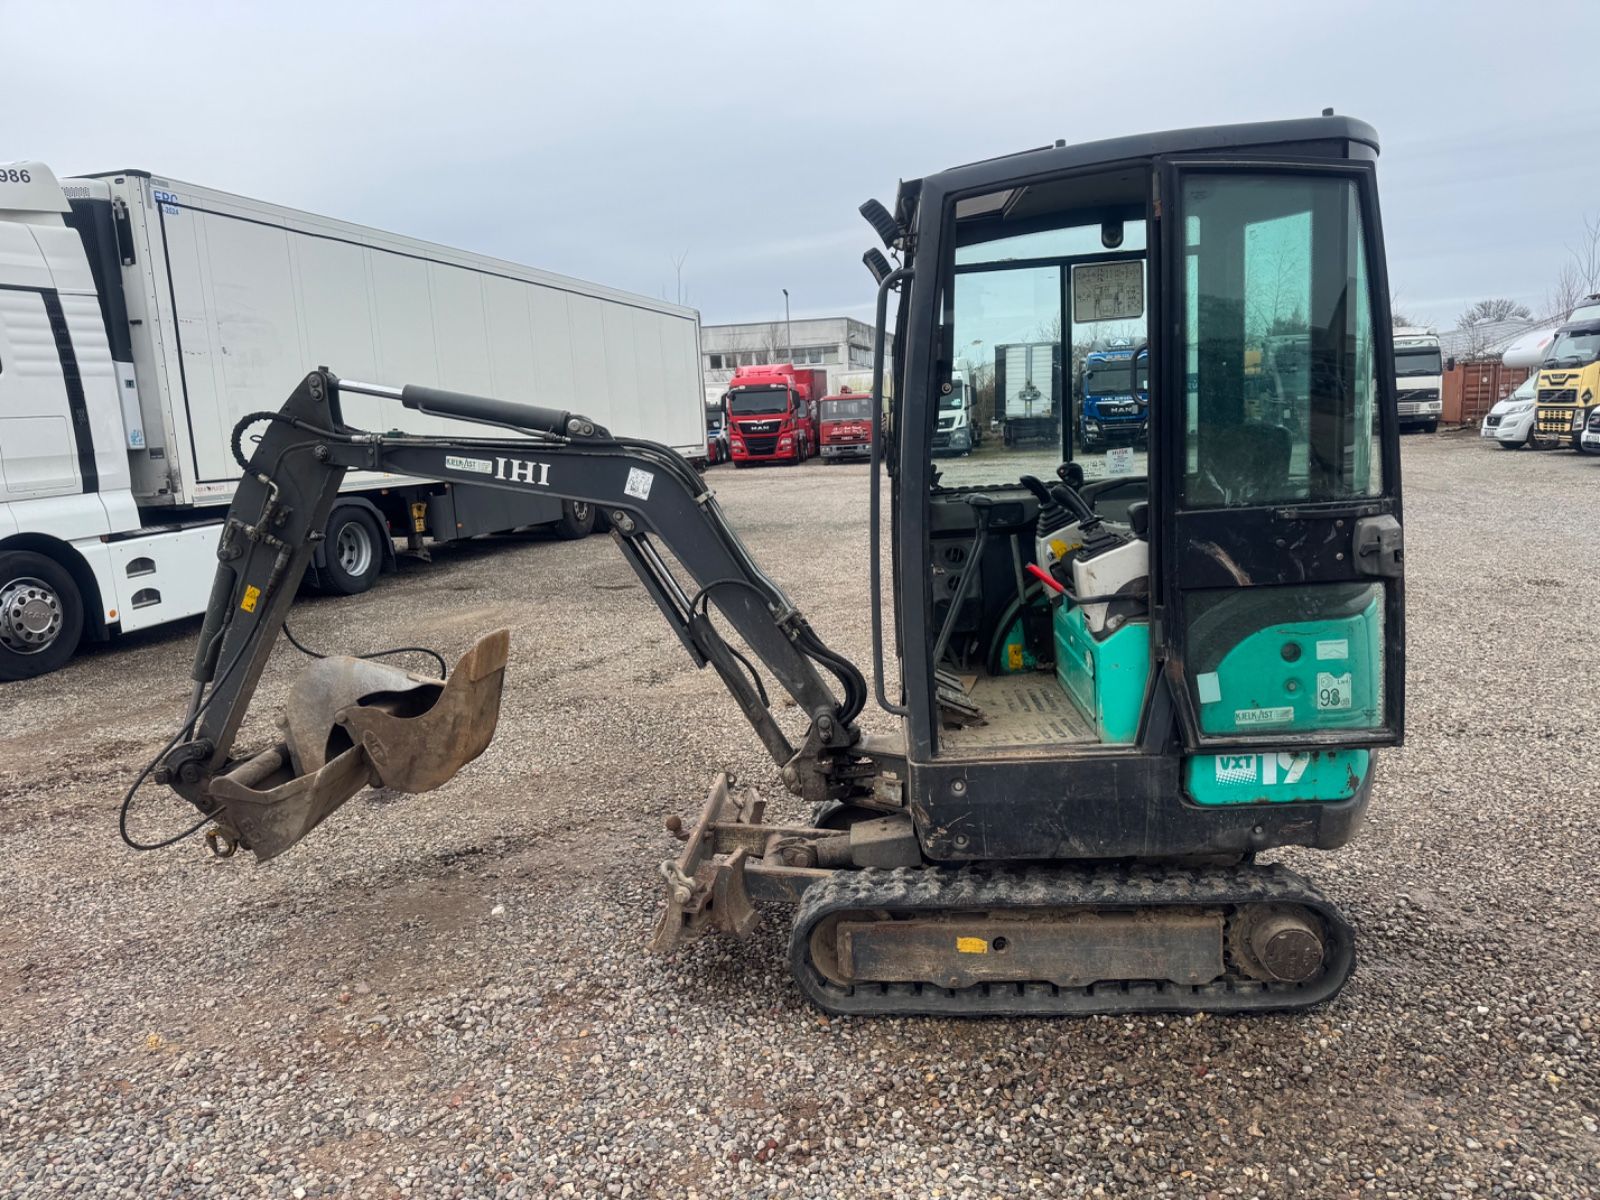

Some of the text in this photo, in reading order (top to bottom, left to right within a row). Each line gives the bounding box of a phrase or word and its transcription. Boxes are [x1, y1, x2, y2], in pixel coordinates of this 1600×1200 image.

[0, 169, 31, 183] 986
[494, 456, 551, 486] IHI
[1220, 753, 1310, 785] VXT 19
